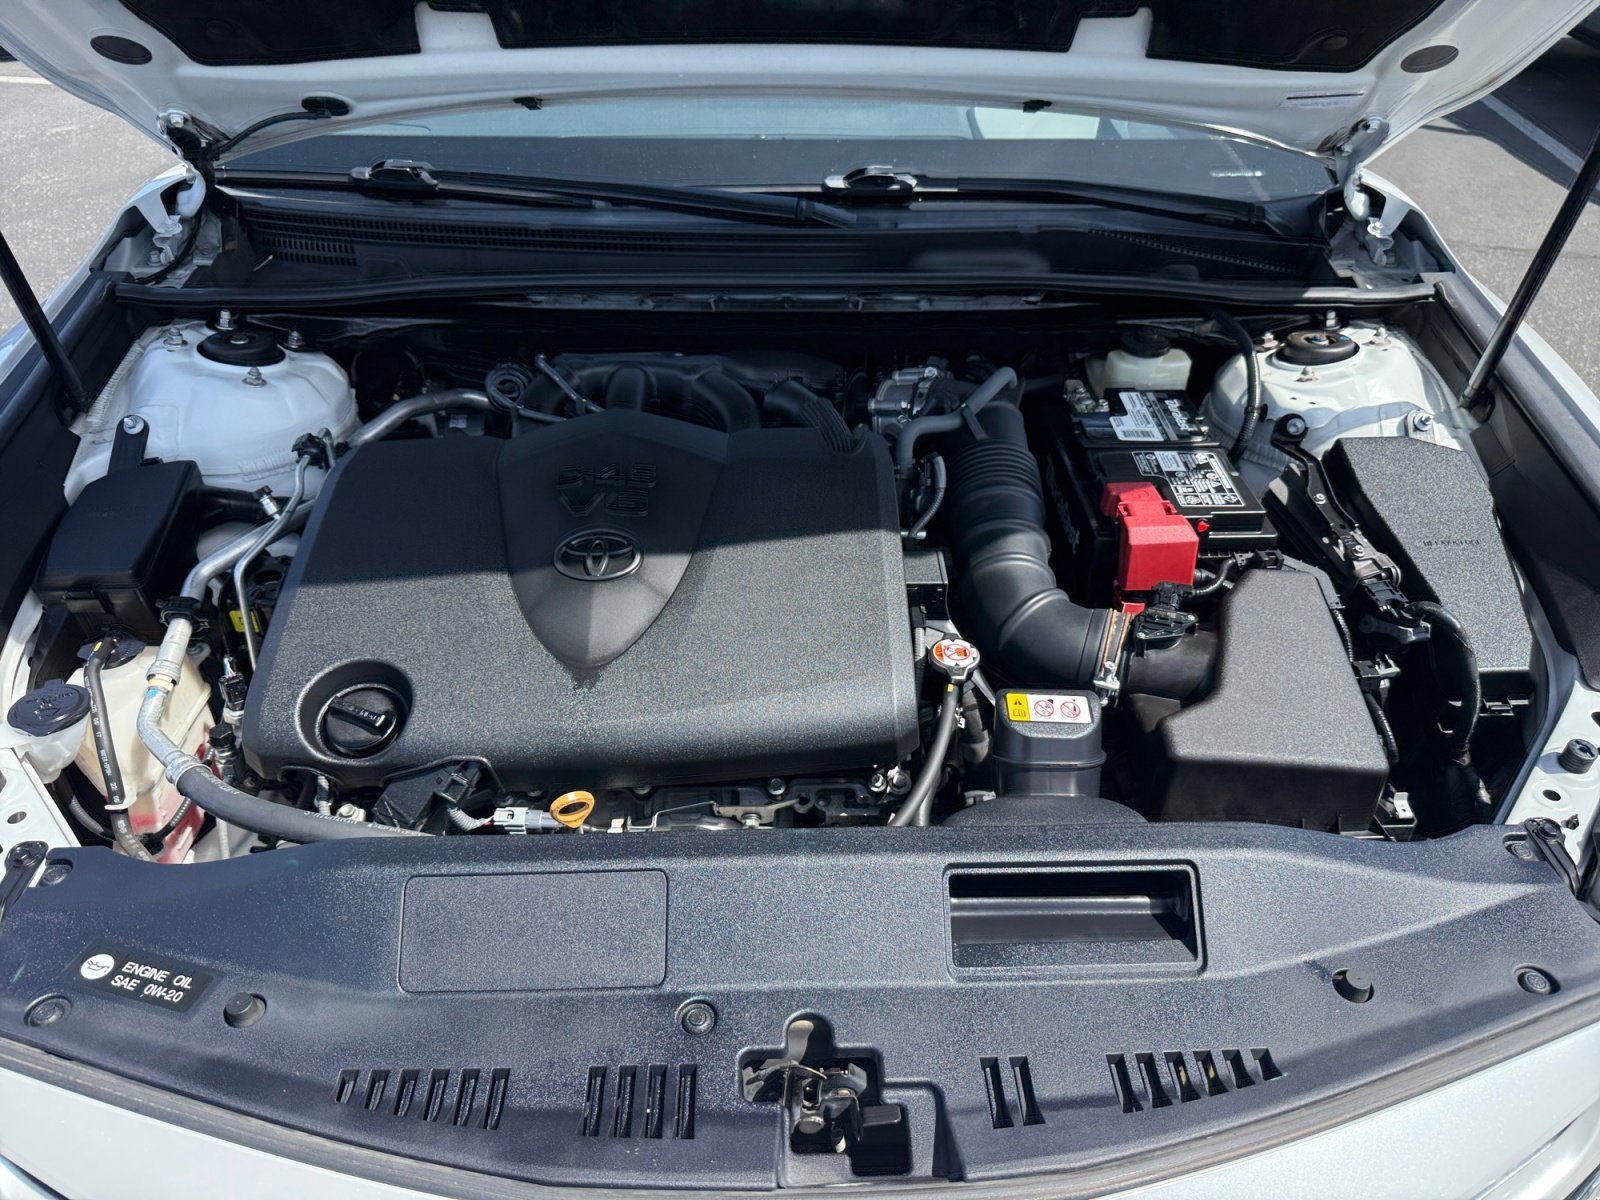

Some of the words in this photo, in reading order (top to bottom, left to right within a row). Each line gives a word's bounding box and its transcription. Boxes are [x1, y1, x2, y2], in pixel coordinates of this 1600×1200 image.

[558, 488, 649, 517] V6
[110, 975, 141, 991] SAE
[143, 983, 184, 1003] 0W-20
[122, 961, 170, 982] ENGINE
[173, 975, 193, 989] OIL
